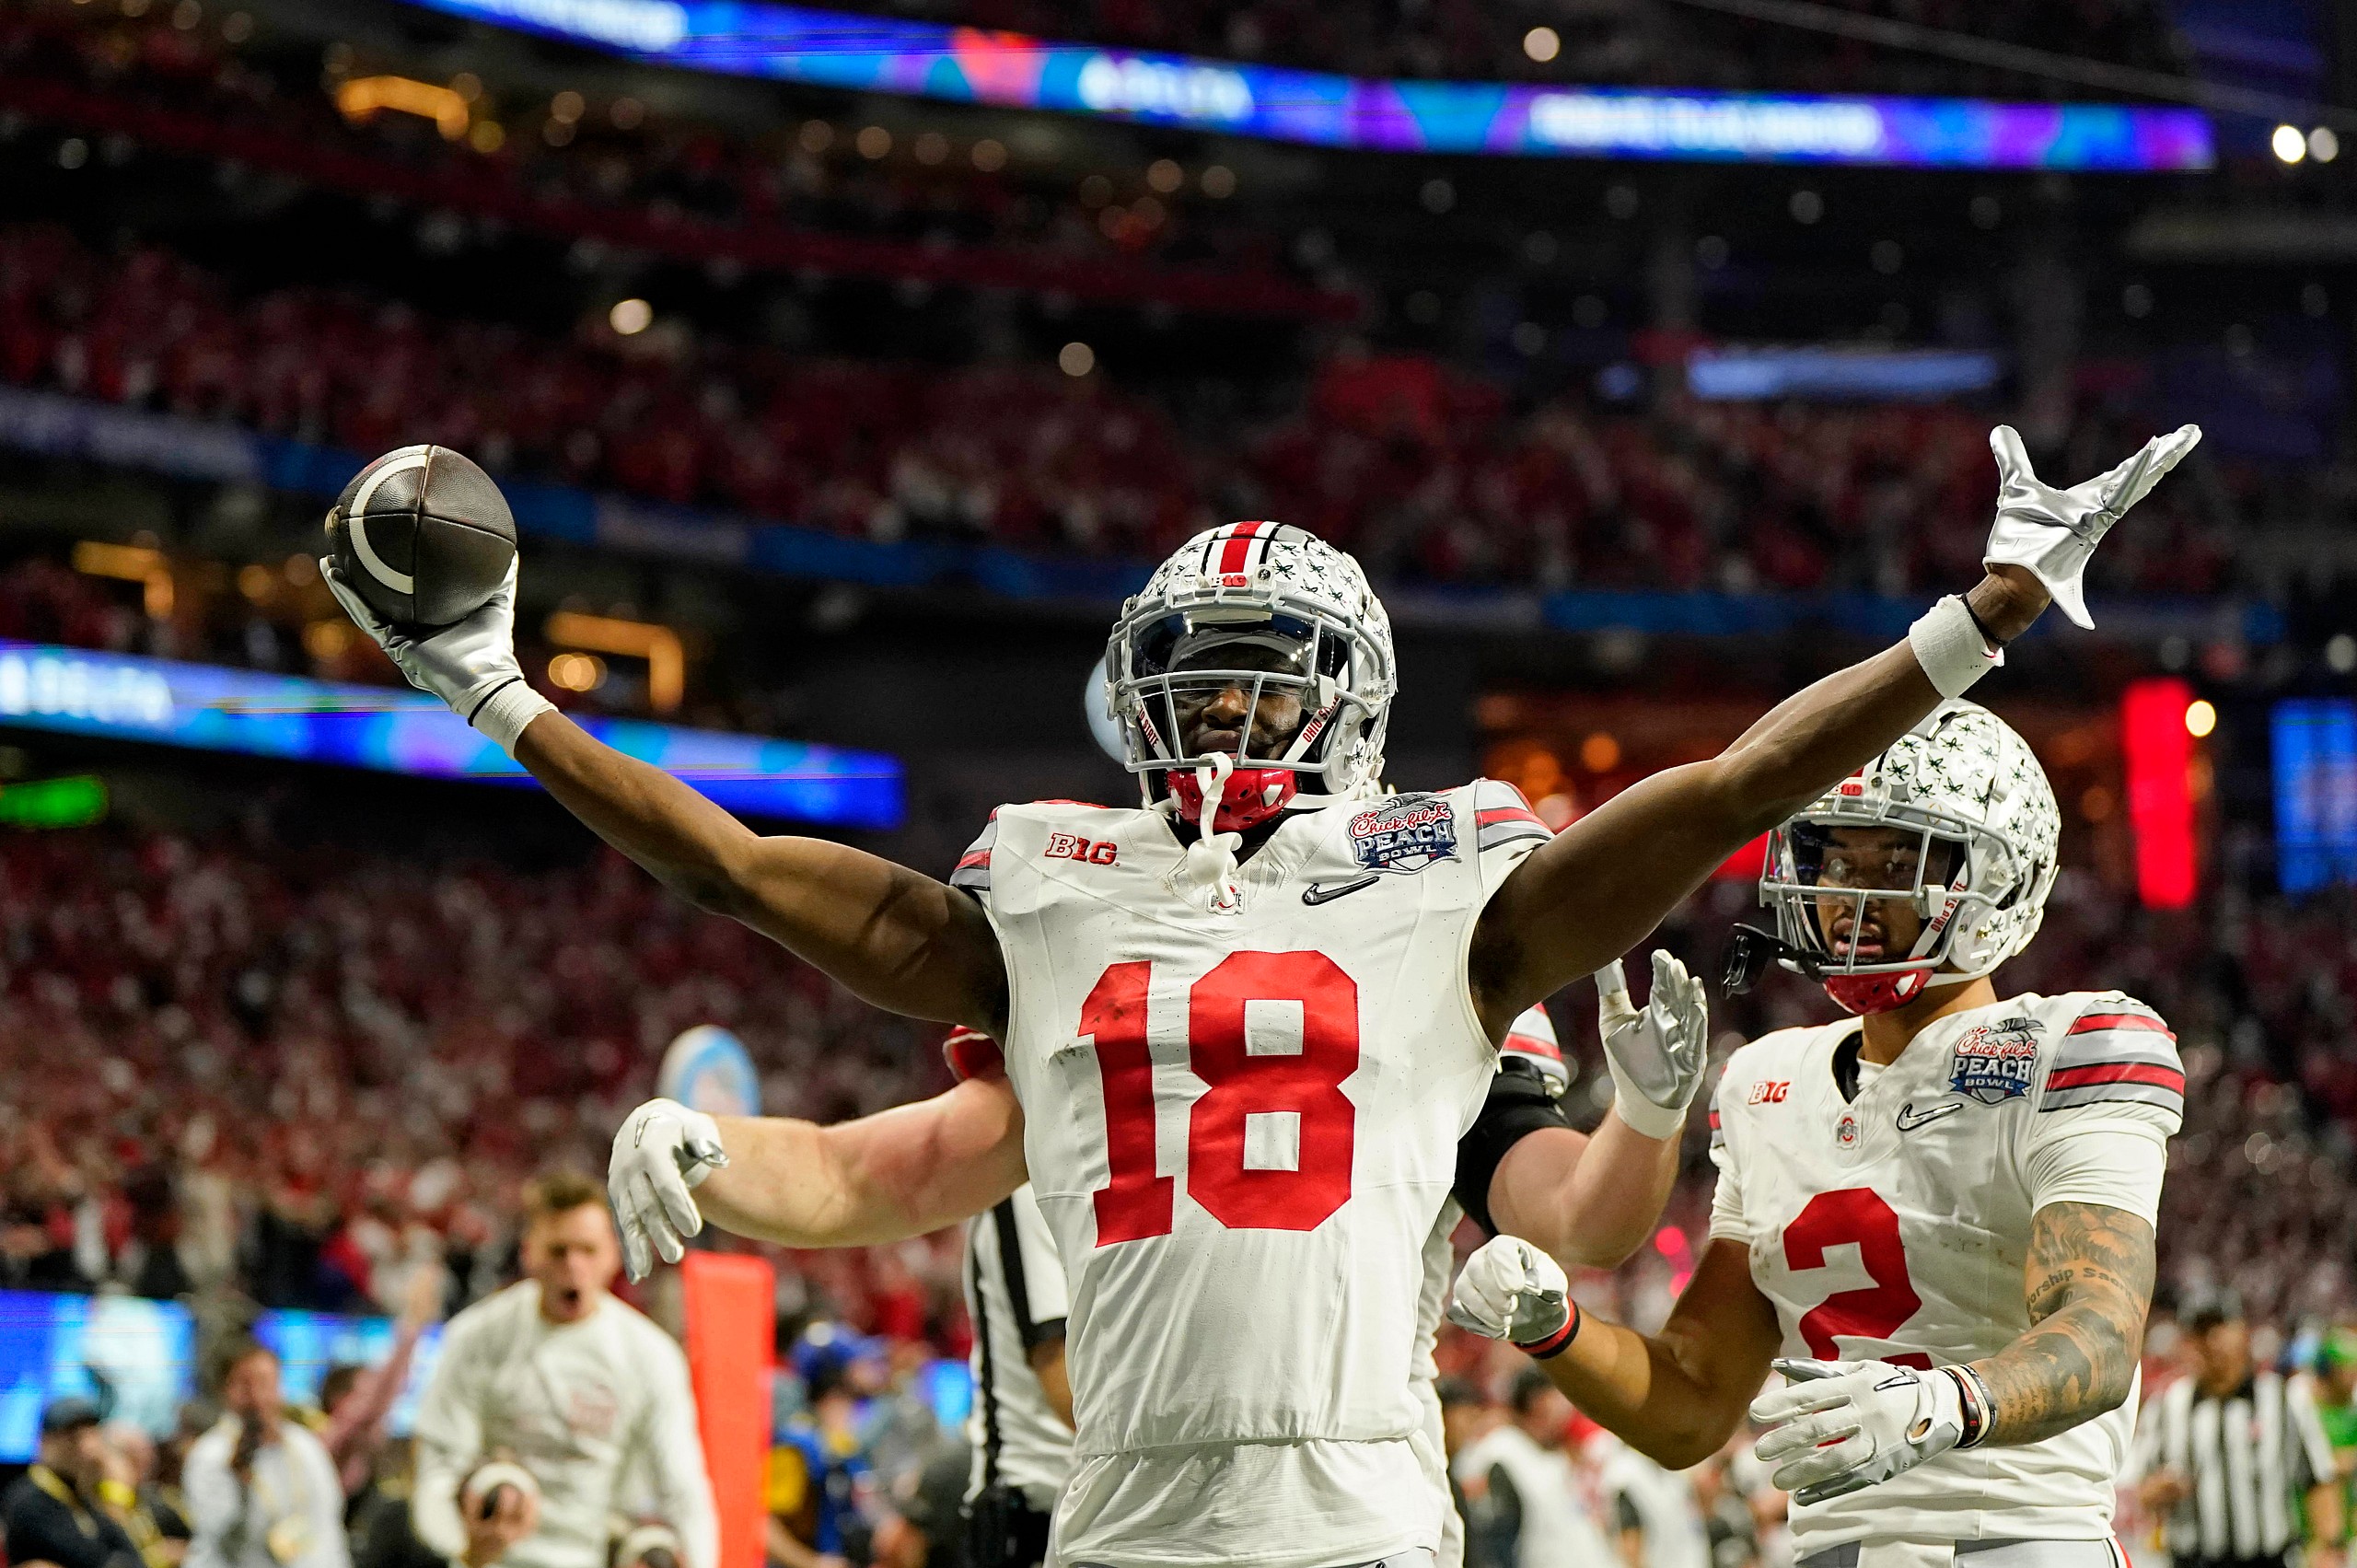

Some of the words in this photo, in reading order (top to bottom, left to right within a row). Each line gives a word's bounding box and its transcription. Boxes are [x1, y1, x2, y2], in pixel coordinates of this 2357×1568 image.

[1144, 719, 1159, 749] STATE
[1302, 717, 1323, 743] OHIO
[1352, 804, 1450, 838] Chick-fil-A
[1356, 821, 1456, 861] PEACH
[1379, 845, 1437, 862] BOWL
[1956, 1028, 2037, 1060] Chick-fil-A
[1950, 1057, 2034, 1085] PEACH
[1965, 1078, 2014, 1089] BOWL
[1078, 949, 1360, 1249] 18
[1782, 1187, 1934, 1447] 2
